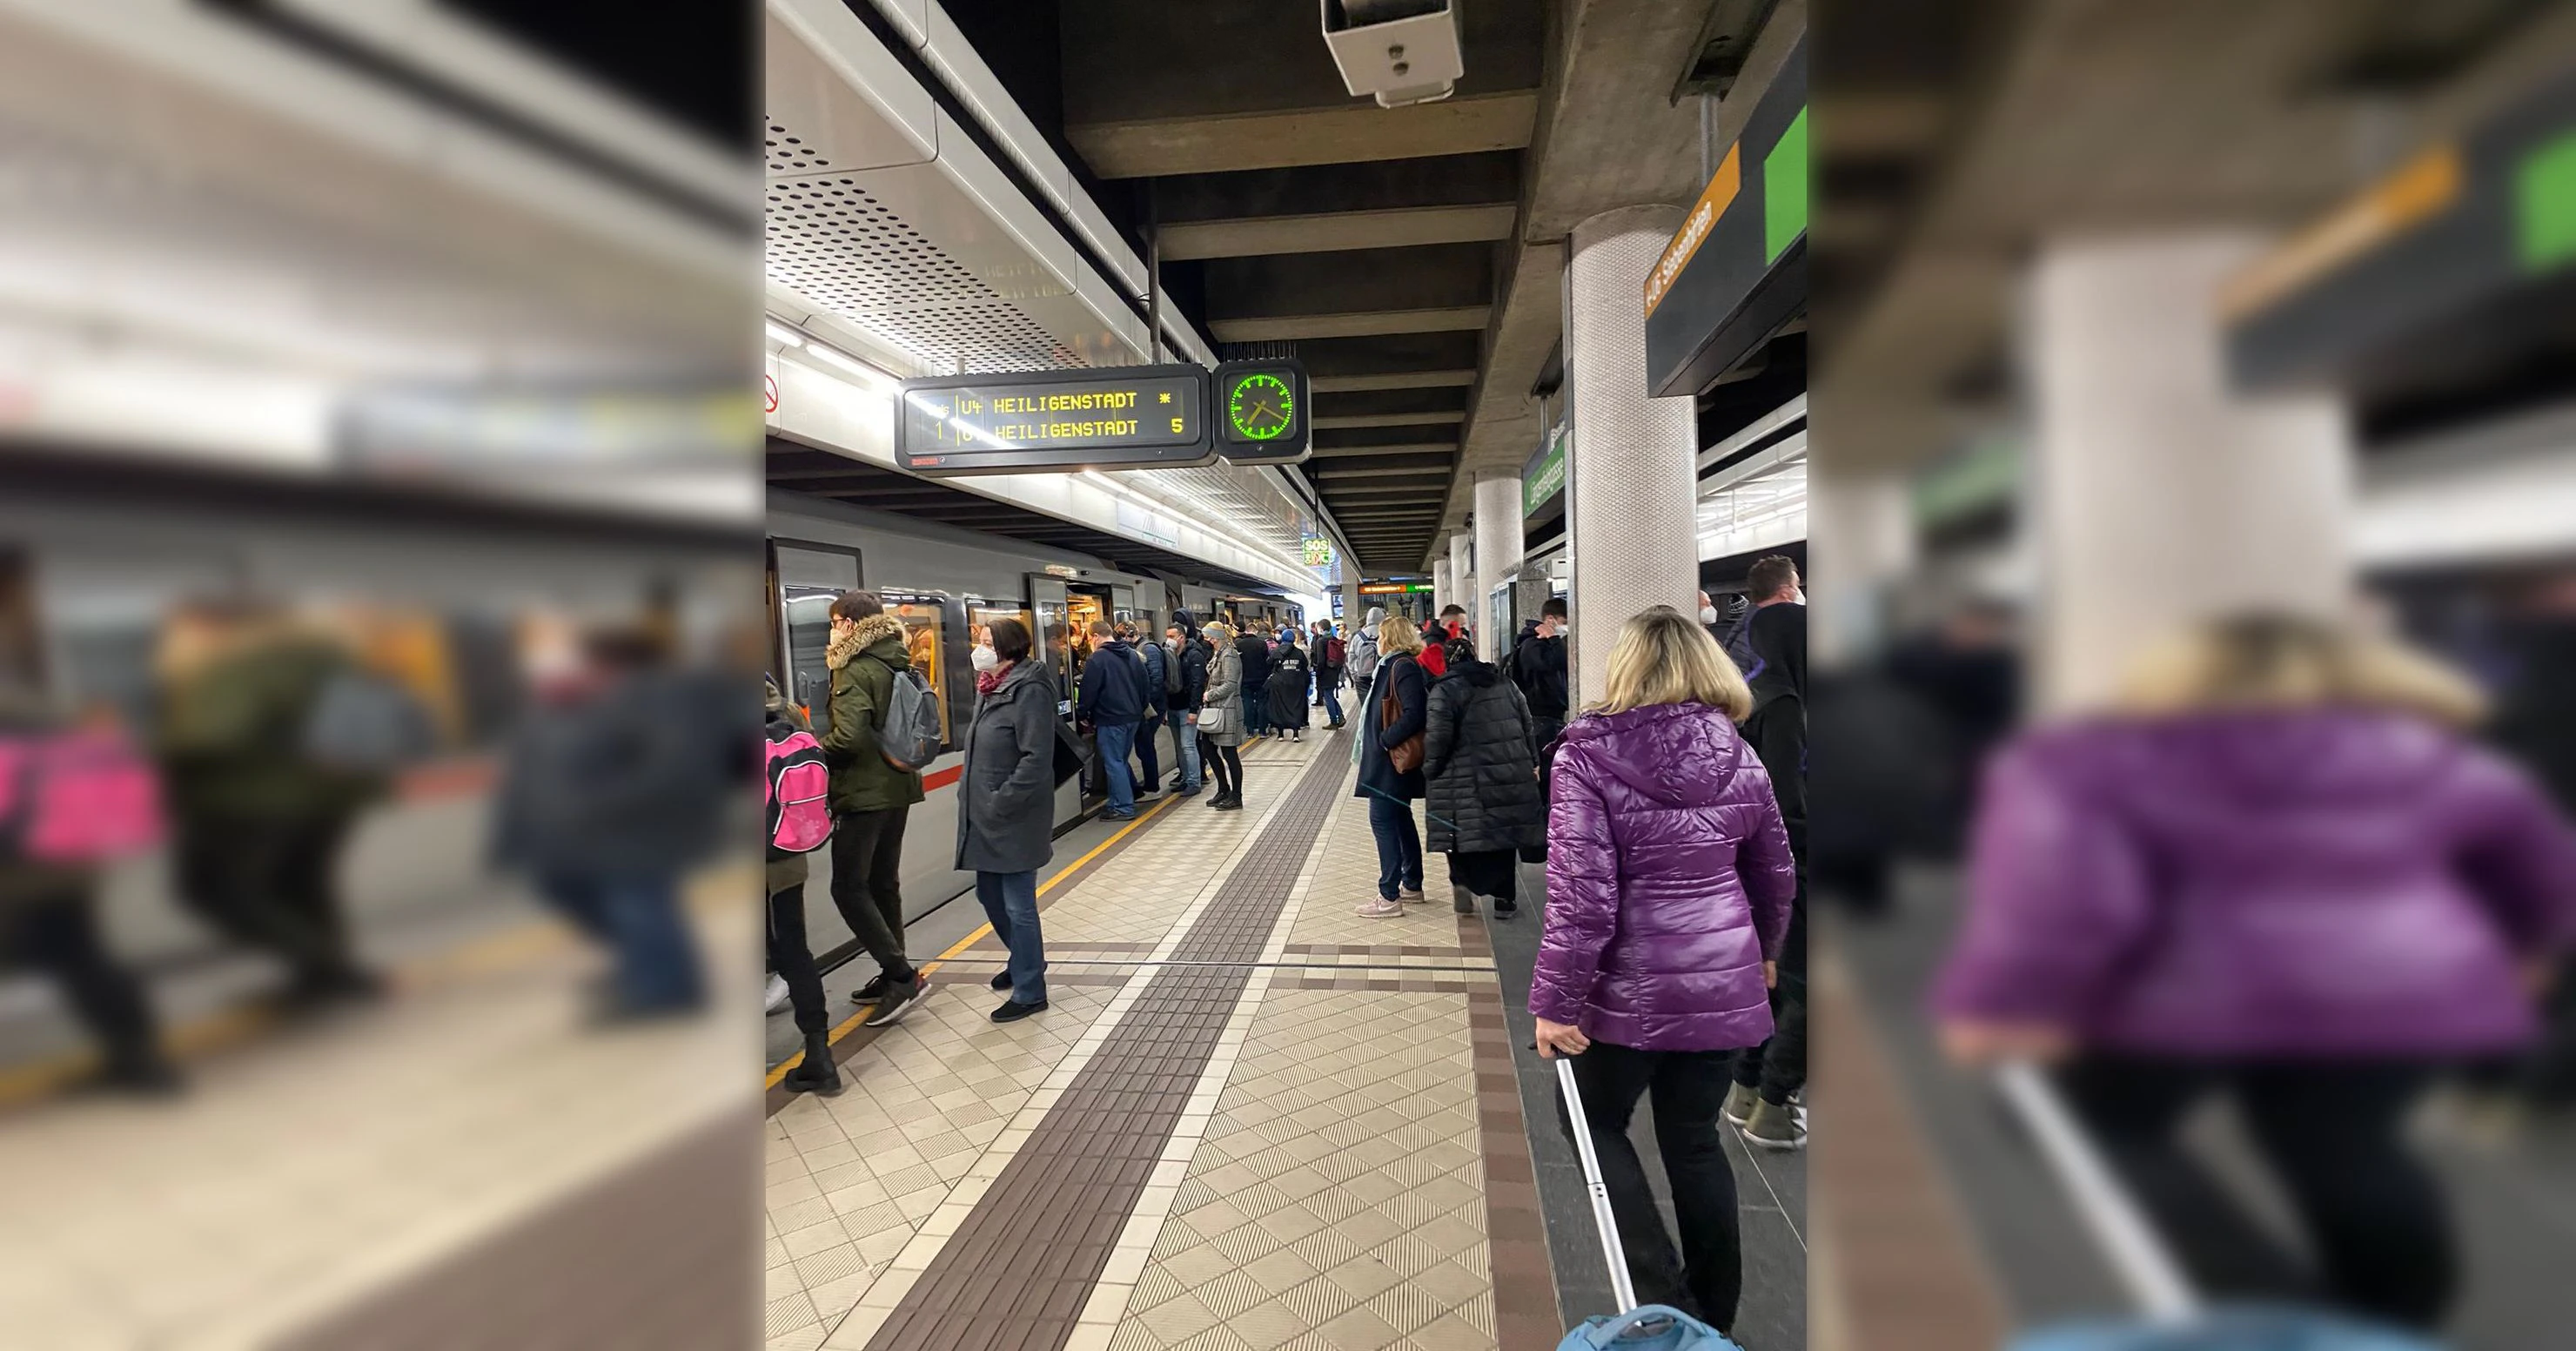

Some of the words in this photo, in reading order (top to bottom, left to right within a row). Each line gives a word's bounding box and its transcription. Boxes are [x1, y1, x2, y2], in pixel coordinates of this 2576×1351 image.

[962, 400, 983, 415] U4
[994, 392, 1137, 413] HEILIGENSTADT
[935, 420, 943, 440] 1
[995, 420, 1138, 440] HEILIGENSTADT
[1171, 418, 1184, 434] 5
[1305, 540, 1328, 552] SOS
